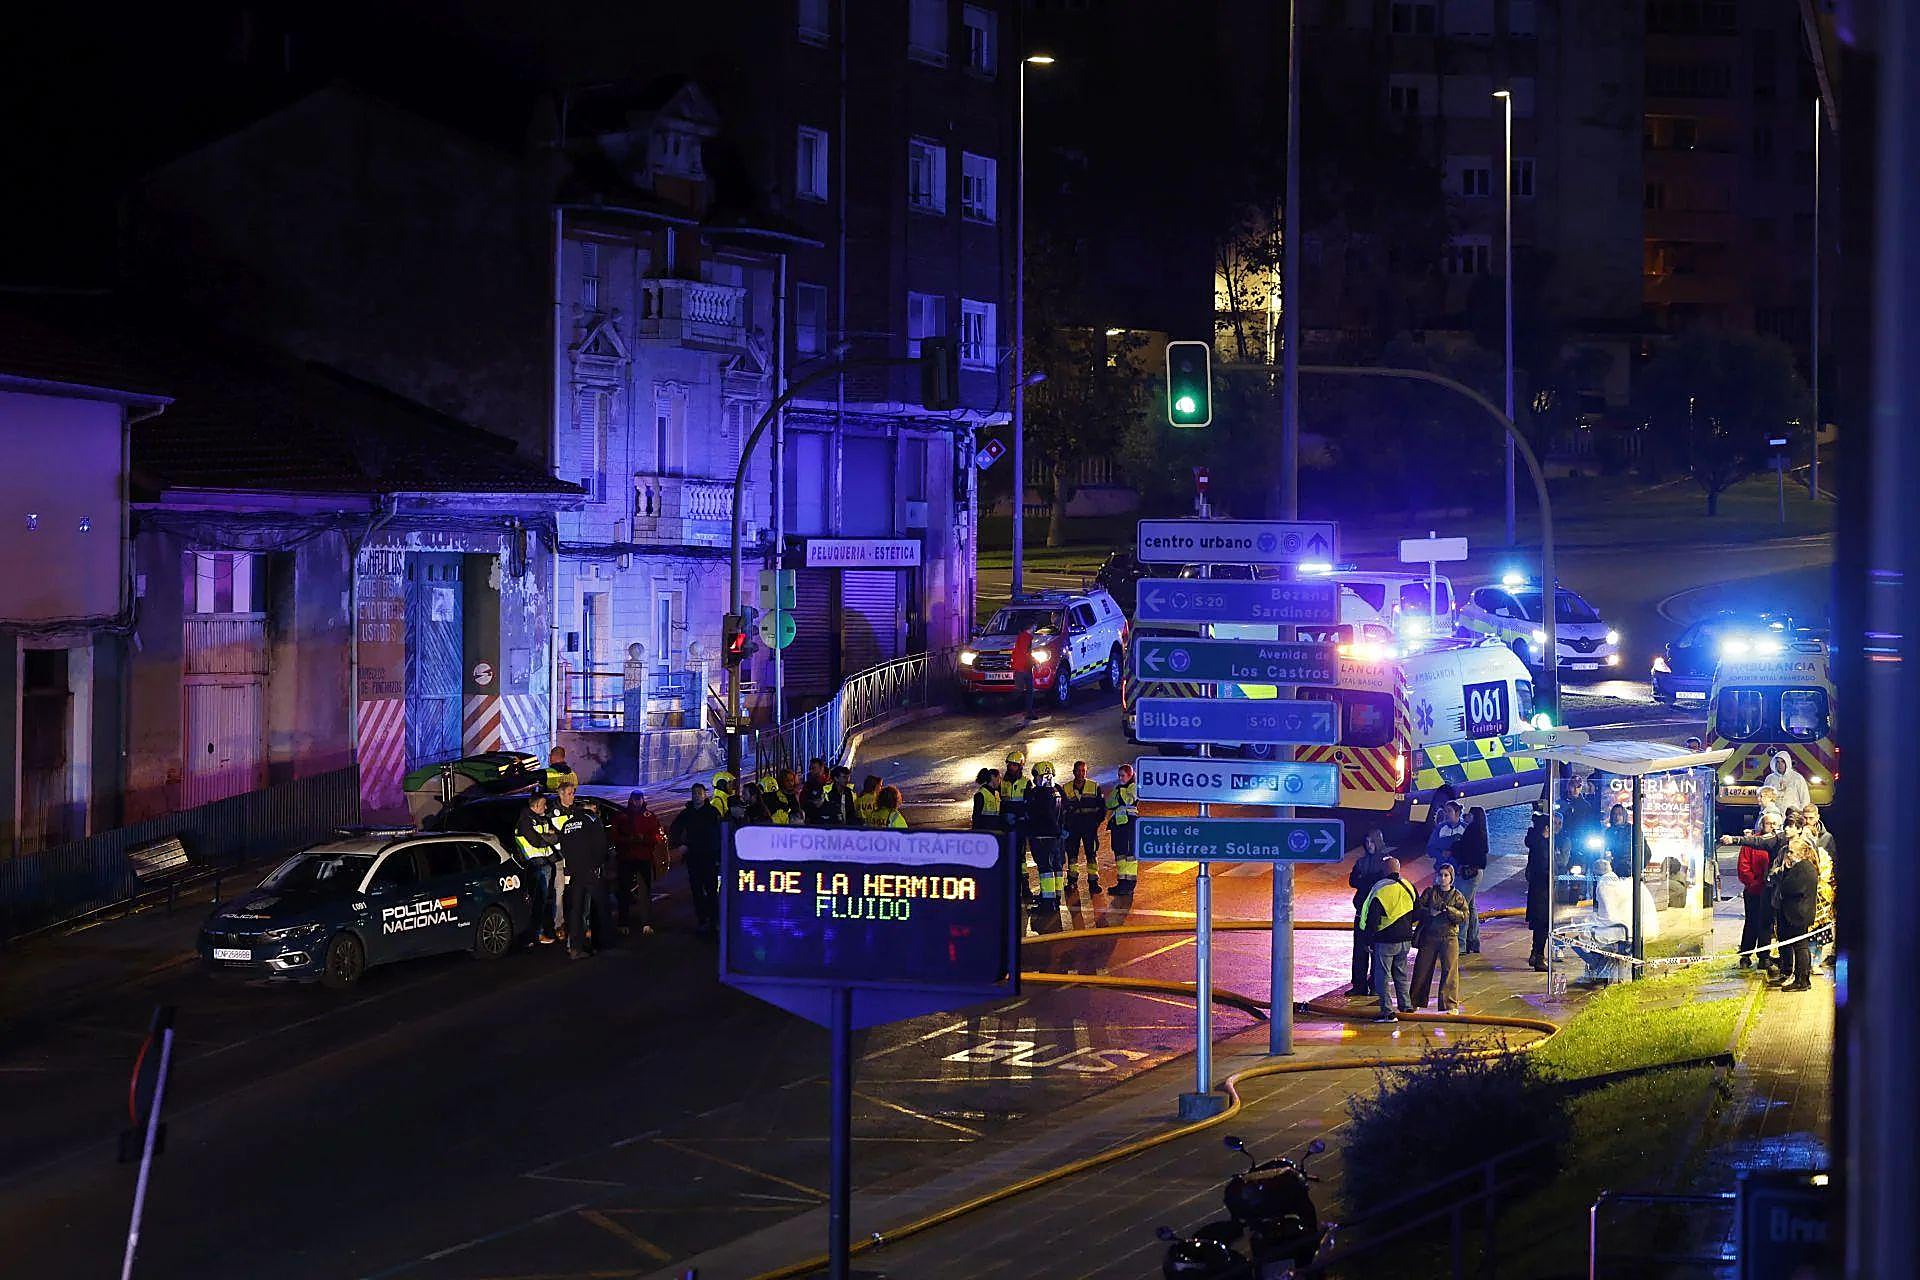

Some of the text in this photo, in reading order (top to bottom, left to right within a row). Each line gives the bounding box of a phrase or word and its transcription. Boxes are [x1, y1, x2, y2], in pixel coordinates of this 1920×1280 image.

[1145, 535, 1253, 549] centro urbano
[1196, 595, 1224, 607] S-20
[1251, 605, 1331, 619] Sardinero
[1258, 649, 1308, 660] Avenida
[1231, 664, 1330, 679] Los Castros
[1340, 663, 1385, 675] LANCIA
[1470, 687, 1501, 724] 061
[1143, 712, 1276, 727] Bilbao S-10
[1142, 771, 1223, 788] BURGOS
[1610, 778, 1697, 793] GURLAIN
[1656, 803, 1690, 811] ROYALE
[1143, 825, 1200, 836] Calle de
[1143, 841, 1280, 856] Gutiérrez Solana
[738, 869, 976, 900] M.DE LA HERMIDA
[382, 899, 443, 921] POLICIA
[816, 896, 911, 920] FLUIDO
[383, 910, 458, 934] NACIONAL
[941, 1039, 1150, 1073] BUS
